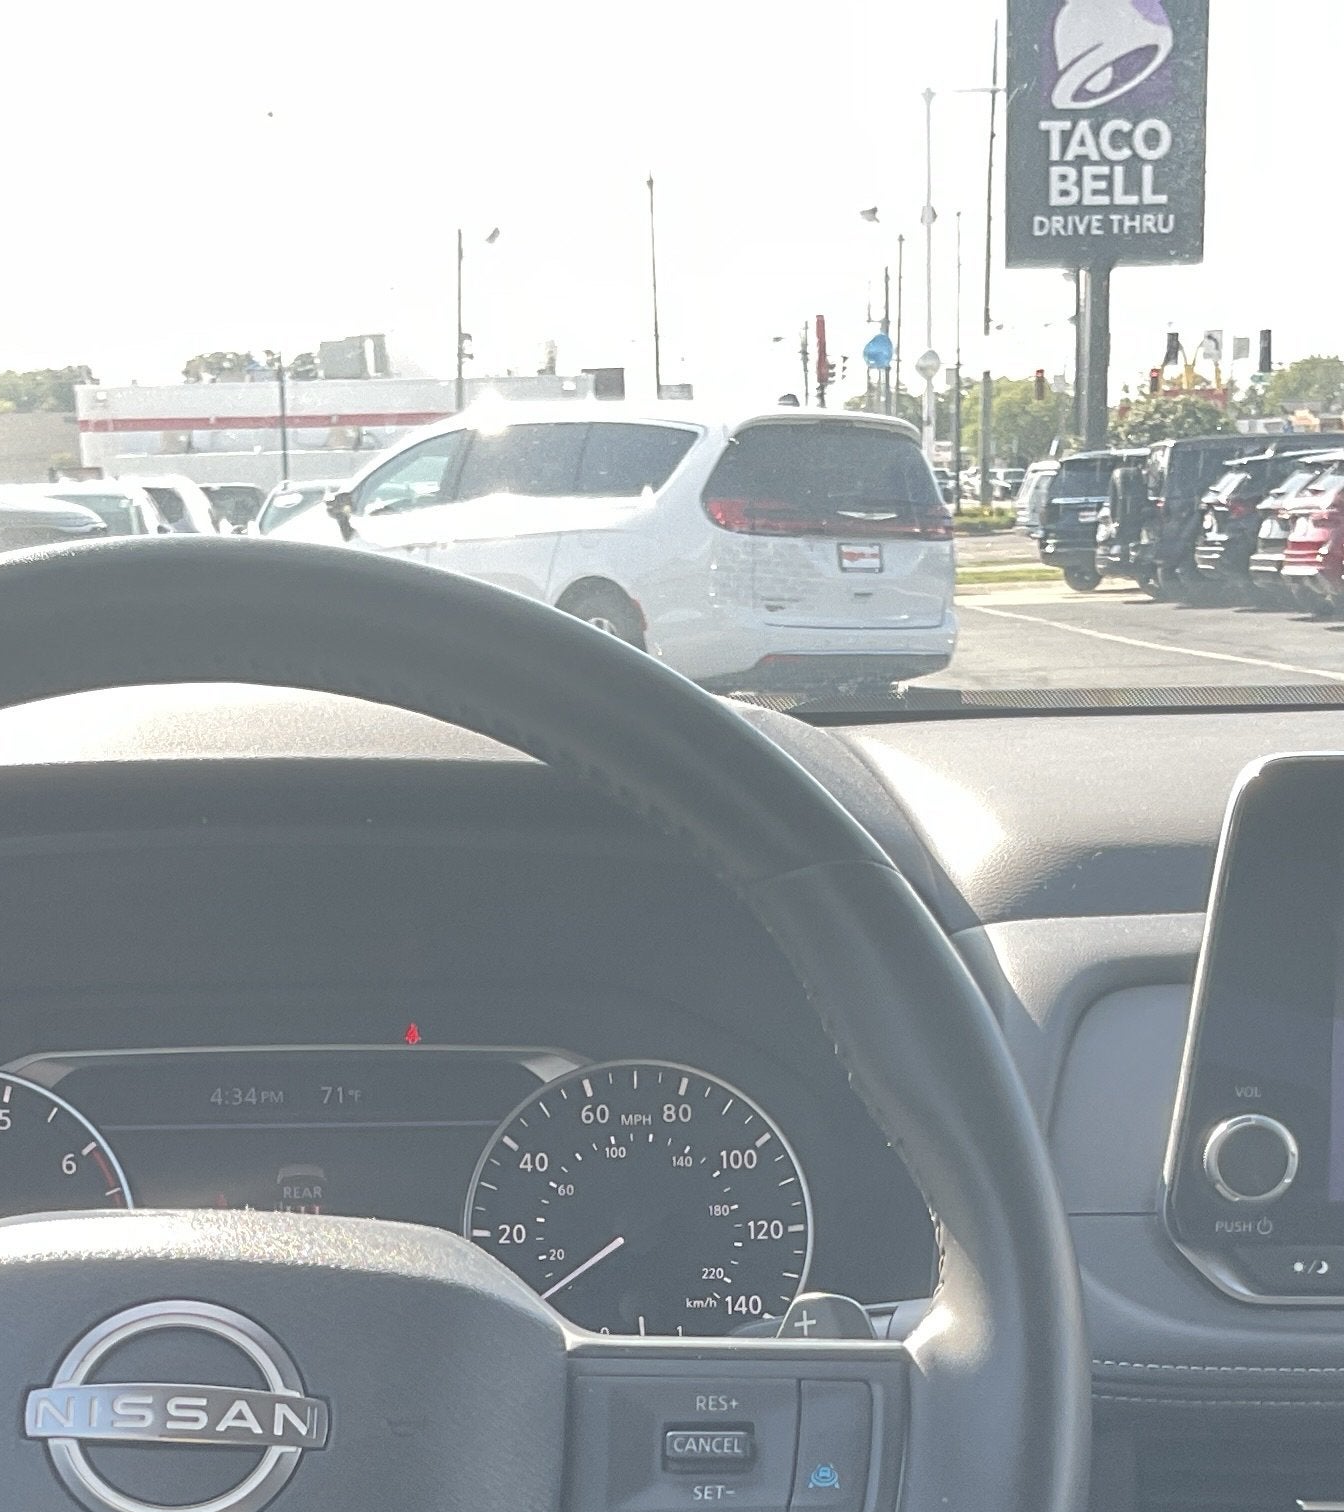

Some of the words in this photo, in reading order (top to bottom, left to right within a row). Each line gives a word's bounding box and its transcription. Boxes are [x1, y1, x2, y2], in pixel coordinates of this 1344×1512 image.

[1038, 118, 1172, 161] TACO
[1049, 165, 1168, 206] BELL
[1032, 215, 1103, 236] DRIVE
[1109, 214, 1175, 235] THRU
[210, 1088, 257, 1105] 4:34
[1235, 1086, 1261, 1098] VOL
[581, 1103, 609, 1124] 60
[620, 1114, 652, 1126] MPH
[663, 1103, 692, 1123] 80
[605, 1147, 627, 1159] 100
[720, 1149, 757, 1170] 100
[61, 1154, 77, 1175] 6
[519, 1152, 549, 1173] 40
[672, 1156, 693, 1168] 140
[283, 1186, 324, 1199] REAR
[557, 1184, 574, 1197] 60
[708, 1204, 730, 1217] 180
[498, 1224, 526, 1244] 20
[747, 1220, 783, 1240] 120
[1215, 1220, 1253, 1233] PUSH
[549, 1249, 565, 1261] 20
[701, 1267, 724, 1280] 220
[686, 1297, 717, 1310] km/h
[725, 1295, 762, 1315] 140
[35, 1395, 318, 1439] NISSAN
[673, 1438, 741, 1454] CANCEL
